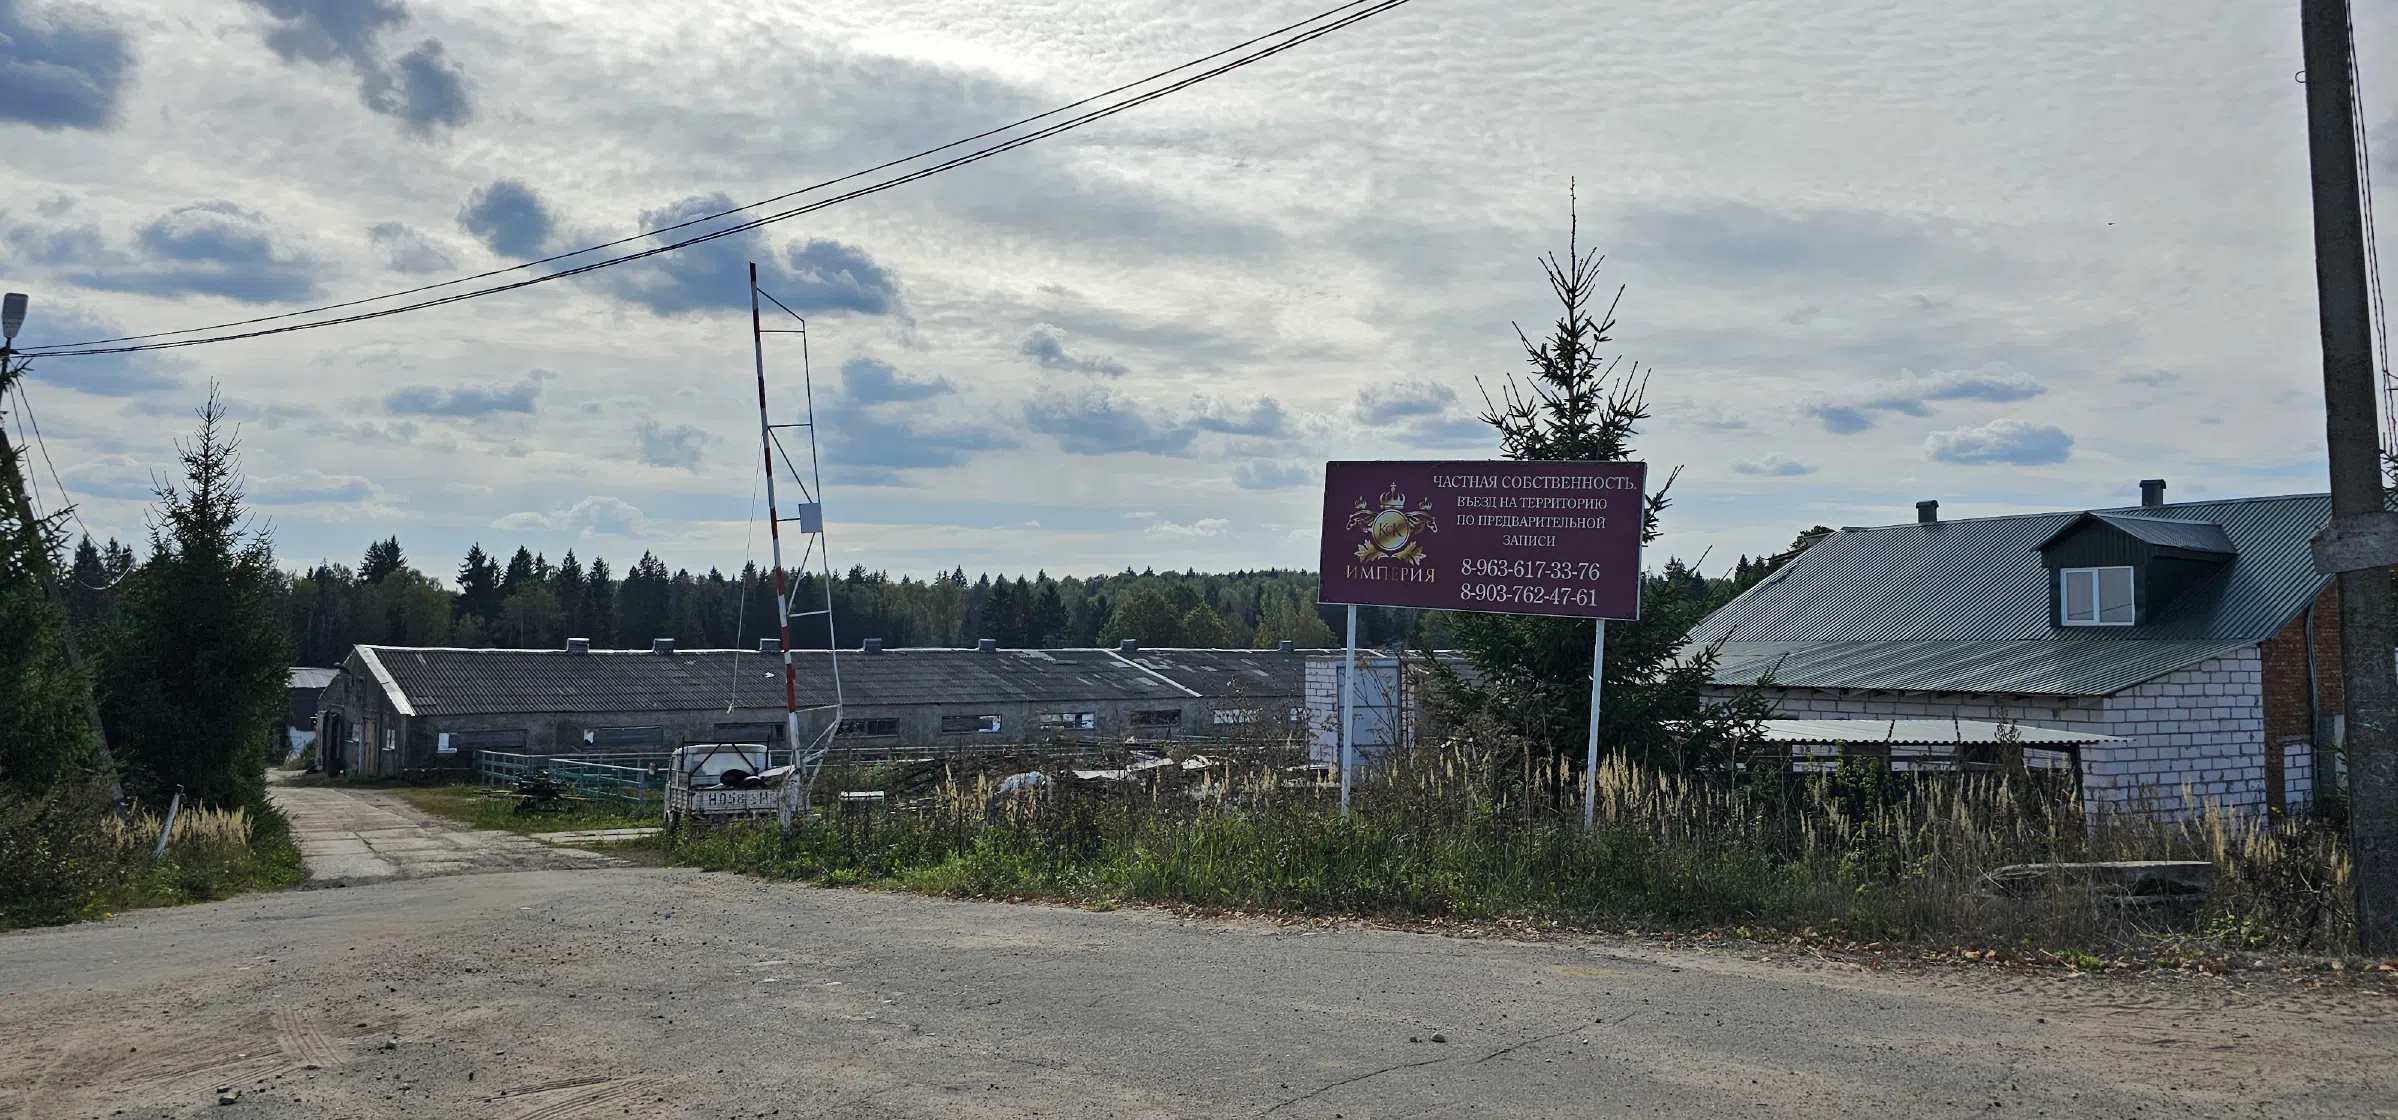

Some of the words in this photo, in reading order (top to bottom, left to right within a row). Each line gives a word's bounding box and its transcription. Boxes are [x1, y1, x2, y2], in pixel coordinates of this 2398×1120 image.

[1433, 475, 1498, 488] ЧАСТНАЯ
[1501, 476, 1637, 490] СОБСТВЕННОСТЬ.
[1457, 496, 1497, 509] ВЪЕЗД
[1499, 497, 1519, 508] НА
[1520, 498, 1607, 510] ТЕРРИТОРИЮ
[1457, 515, 1475, 525] ПО
[1478, 515, 1606, 529] ПРЕДВАРИТЕЛЬНОЙ
[1502, 535, 1555, 547] ЗАПИСИ
[1346, 565, 1436, 583] ИМПЕРИЯ
[1461, 558, 1600, 580] 8-963-617-33-76
[1460, 583, 1597, 607] 8-903-762-47-61
